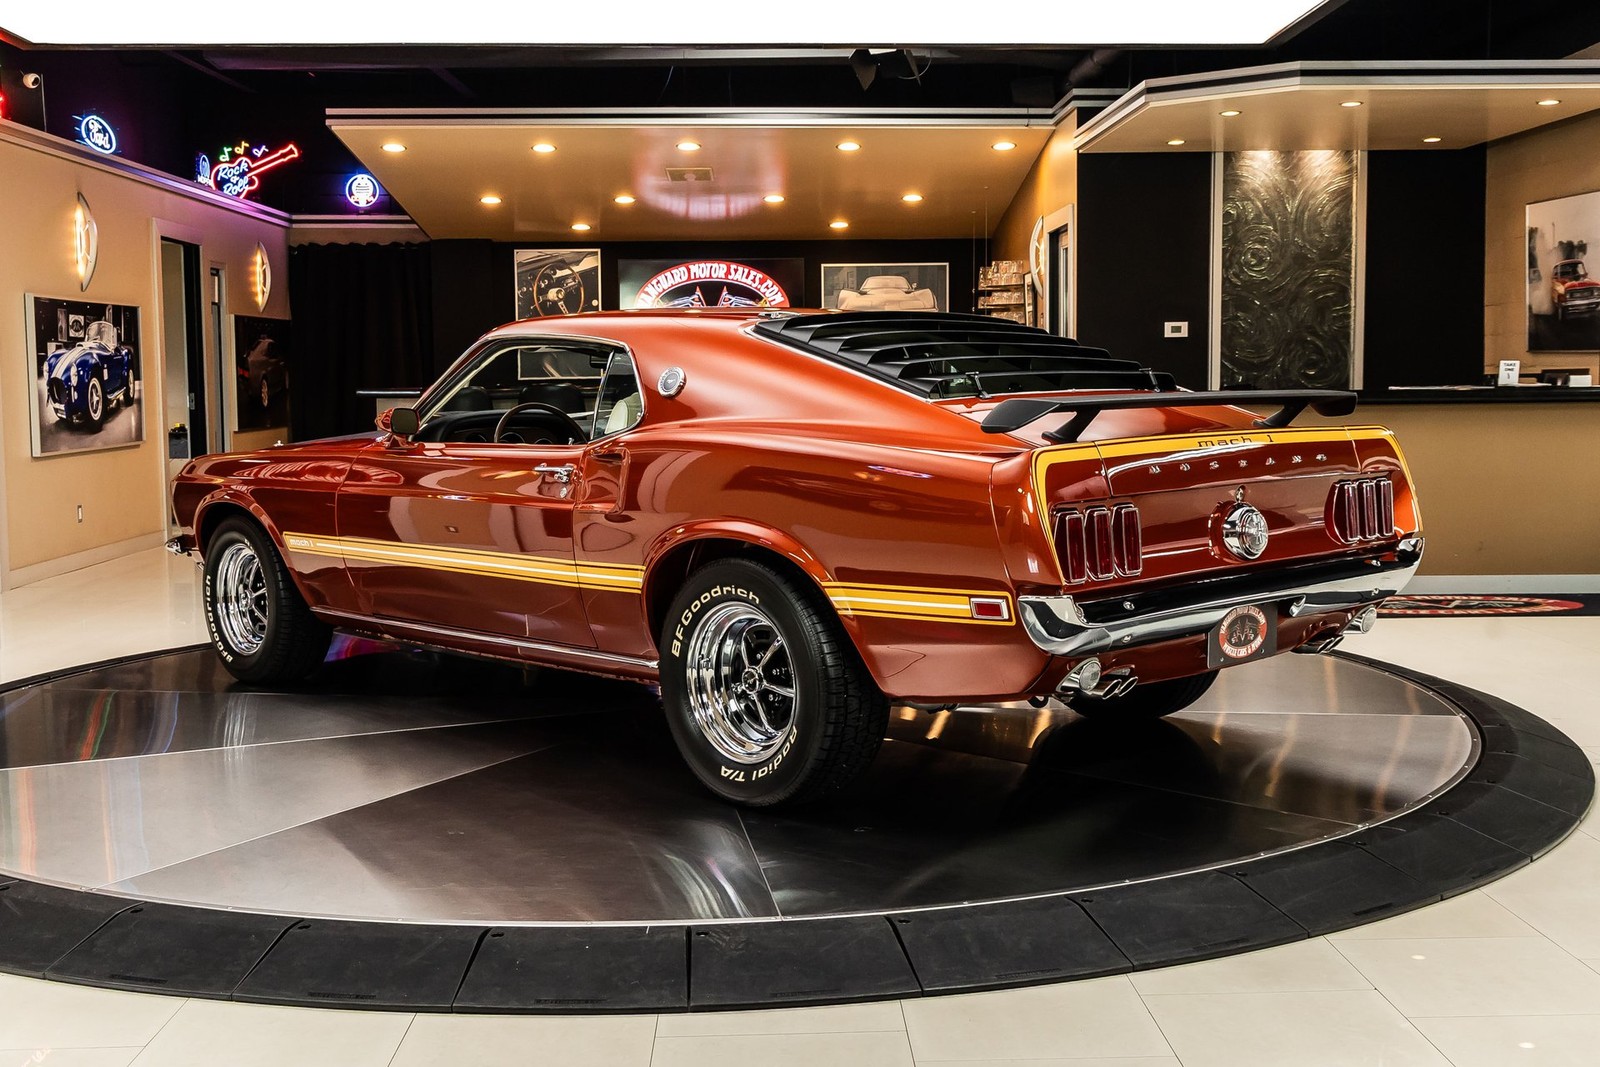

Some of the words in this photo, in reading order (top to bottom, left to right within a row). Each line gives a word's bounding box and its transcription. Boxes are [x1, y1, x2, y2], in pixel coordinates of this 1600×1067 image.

[88, 119, 110, 149] Ford
[217, 160, 249, 181] Rock
[222, 175, 249, 196] Roll
[689, 262, 727, 280] MOTOR
[728, 264, 784, 306] SALES.COM
[1197, 435, 1253, 448] mach
[1266, 434, 1275, 443] 1
[289, 538, 309, 547] mach
[671, 584, 760, 658] BFGoodrich
[751, 725, 798, 781] Radial
[720, 765, 746, 782] T/A
